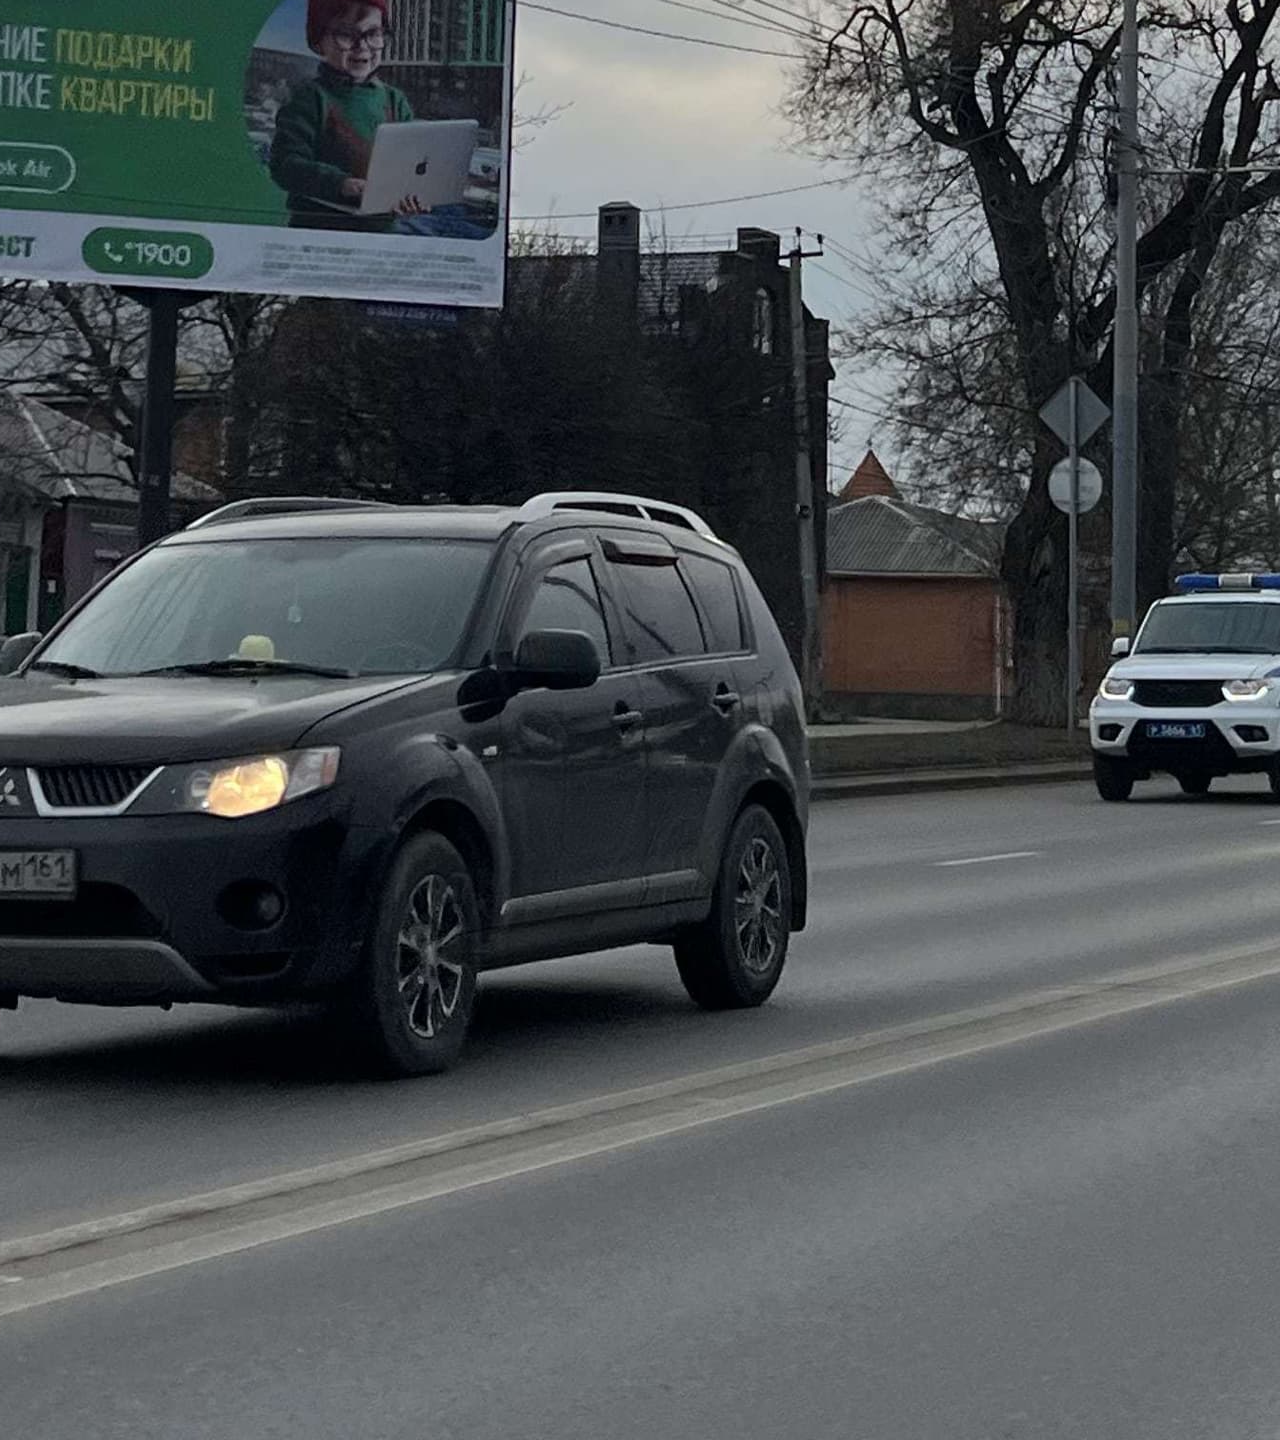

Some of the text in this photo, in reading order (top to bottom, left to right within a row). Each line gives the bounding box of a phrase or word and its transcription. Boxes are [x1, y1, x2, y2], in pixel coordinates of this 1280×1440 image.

[55, 27, 194, 73] ПОДАРКИ
[60, 75, 215, 122] КВАРТИРЫ
[22, 160, 54, 178] Air
